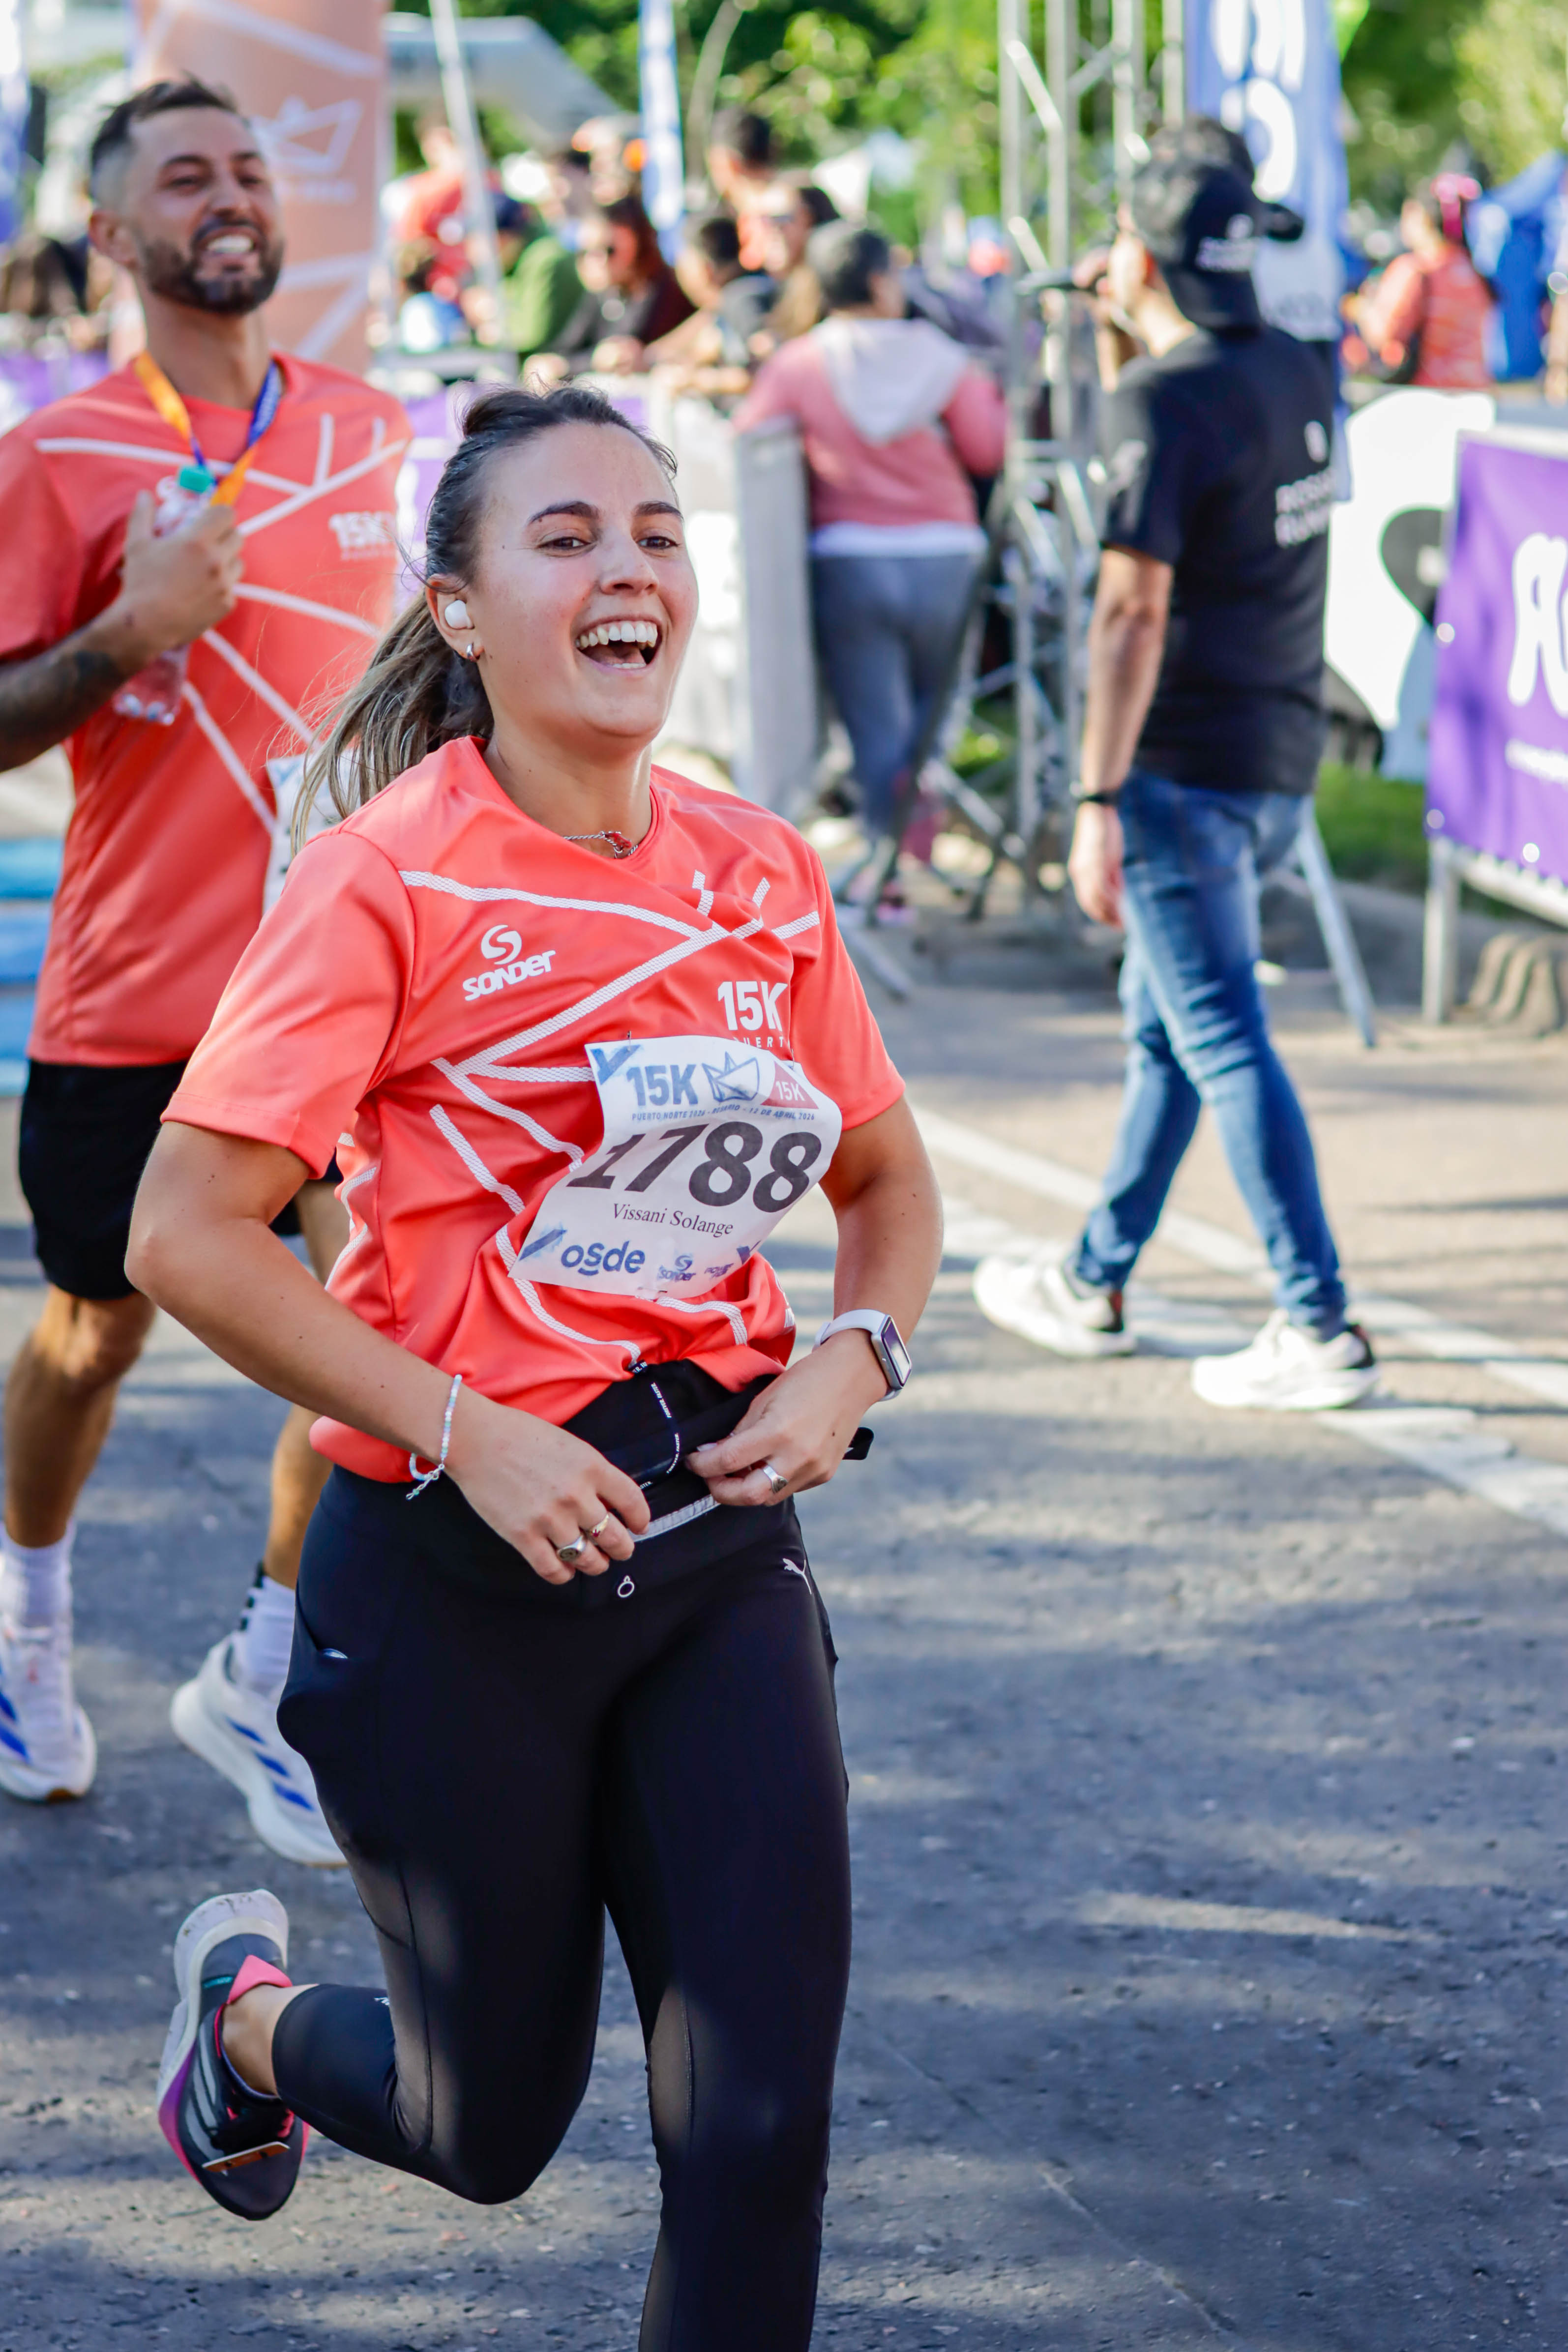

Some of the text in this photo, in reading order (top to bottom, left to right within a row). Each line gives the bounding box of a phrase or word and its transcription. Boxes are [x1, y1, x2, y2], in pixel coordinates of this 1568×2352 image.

[718, 981, 788, 1031] 15K
[733, 1036, 790, 1049] UERT
[626, 1064, 698, 1106] 15K
[775, 1081, 805, 1101] 15K
[664, 1111, 688, 1119] NORTE
[566, 1121, 822, 1212] 1788
[614, 1203, 734, 1237] Vissani Solange
[561, 1240, 645, 1274] osde
[651, 1382, 662, 1398] FASTER.
[640, 1481, 653, 1489] STER.
